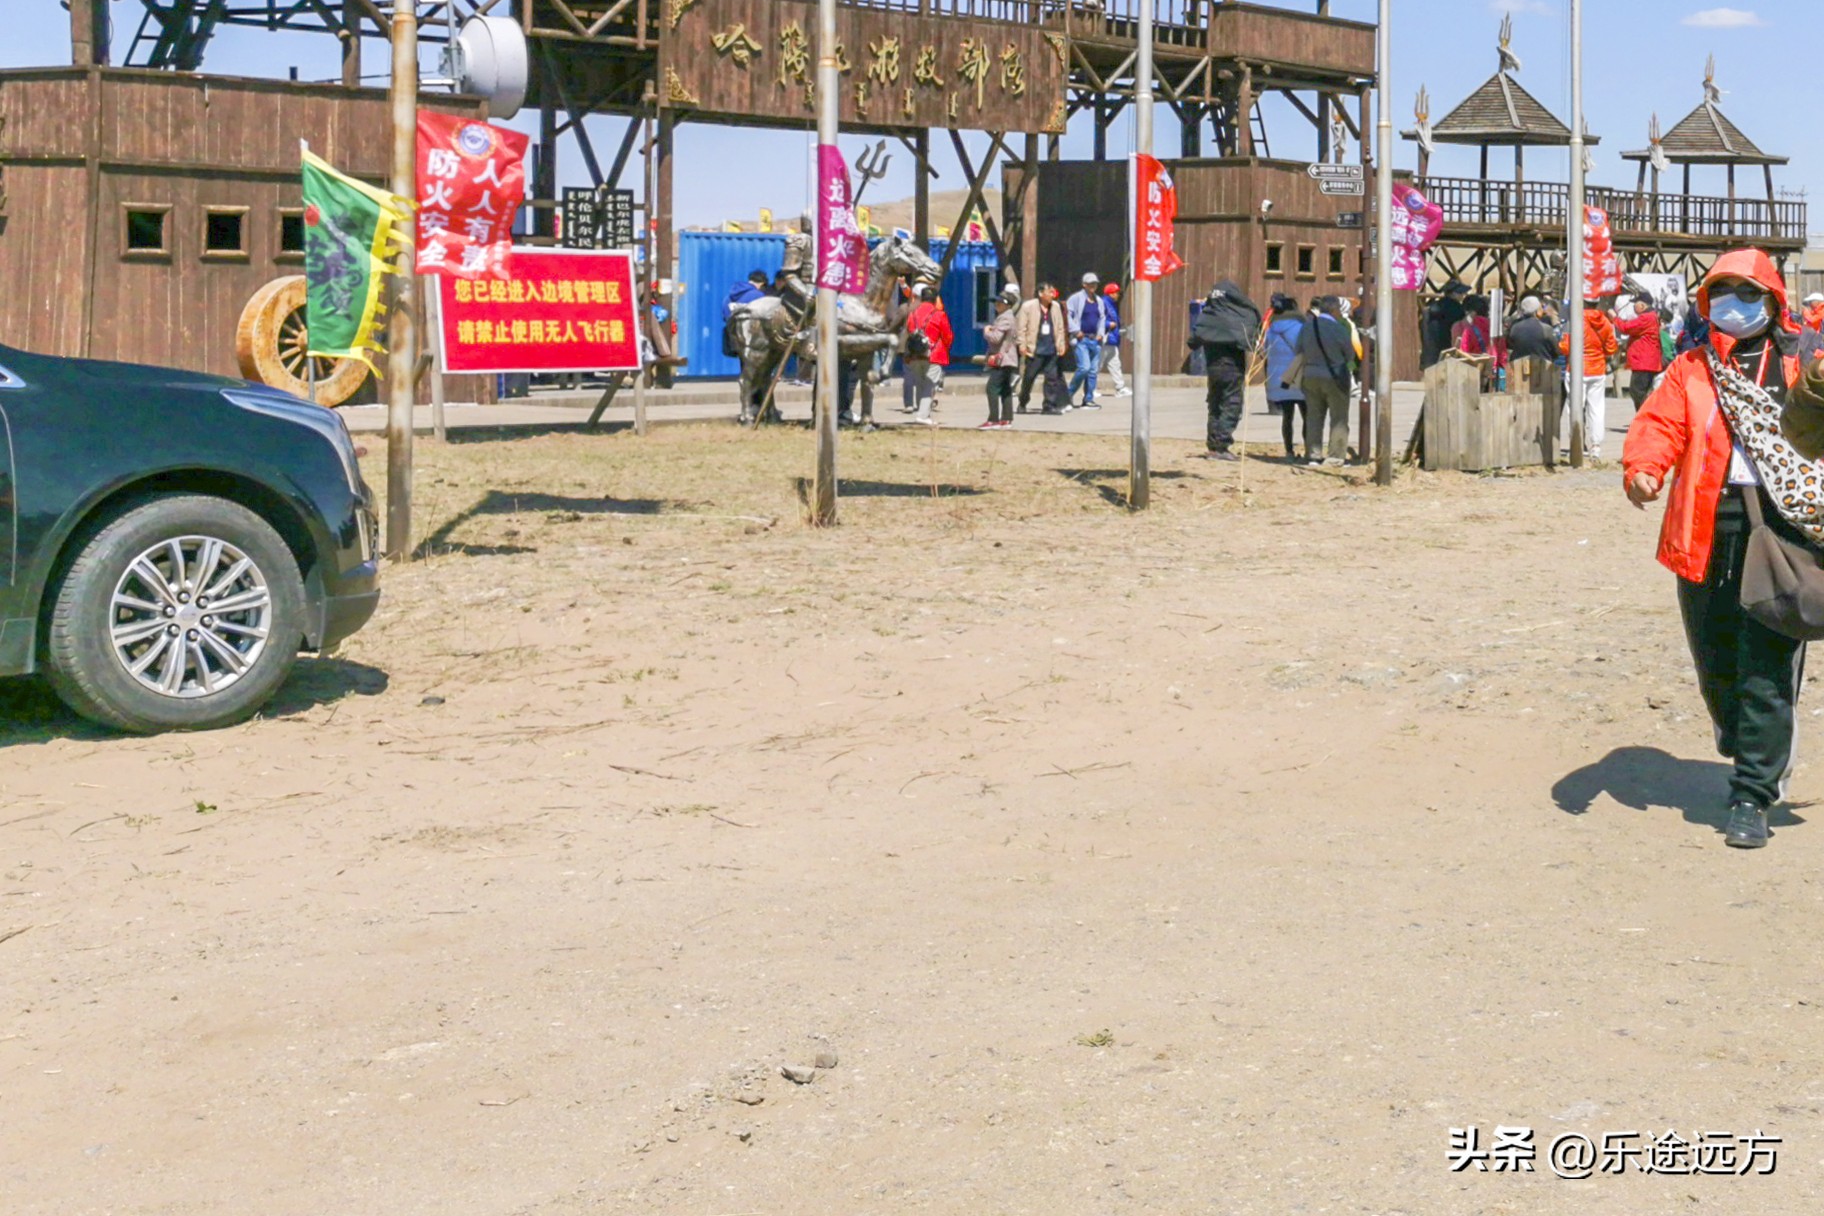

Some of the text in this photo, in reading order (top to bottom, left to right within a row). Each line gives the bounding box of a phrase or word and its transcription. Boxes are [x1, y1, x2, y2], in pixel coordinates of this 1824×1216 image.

[418, 147, 461, 267] 防火安全
[454, 277, 622, 305] 您已经进入边境管理区
[457, 319, 626, 345] 请禁止使用无人飞行器
